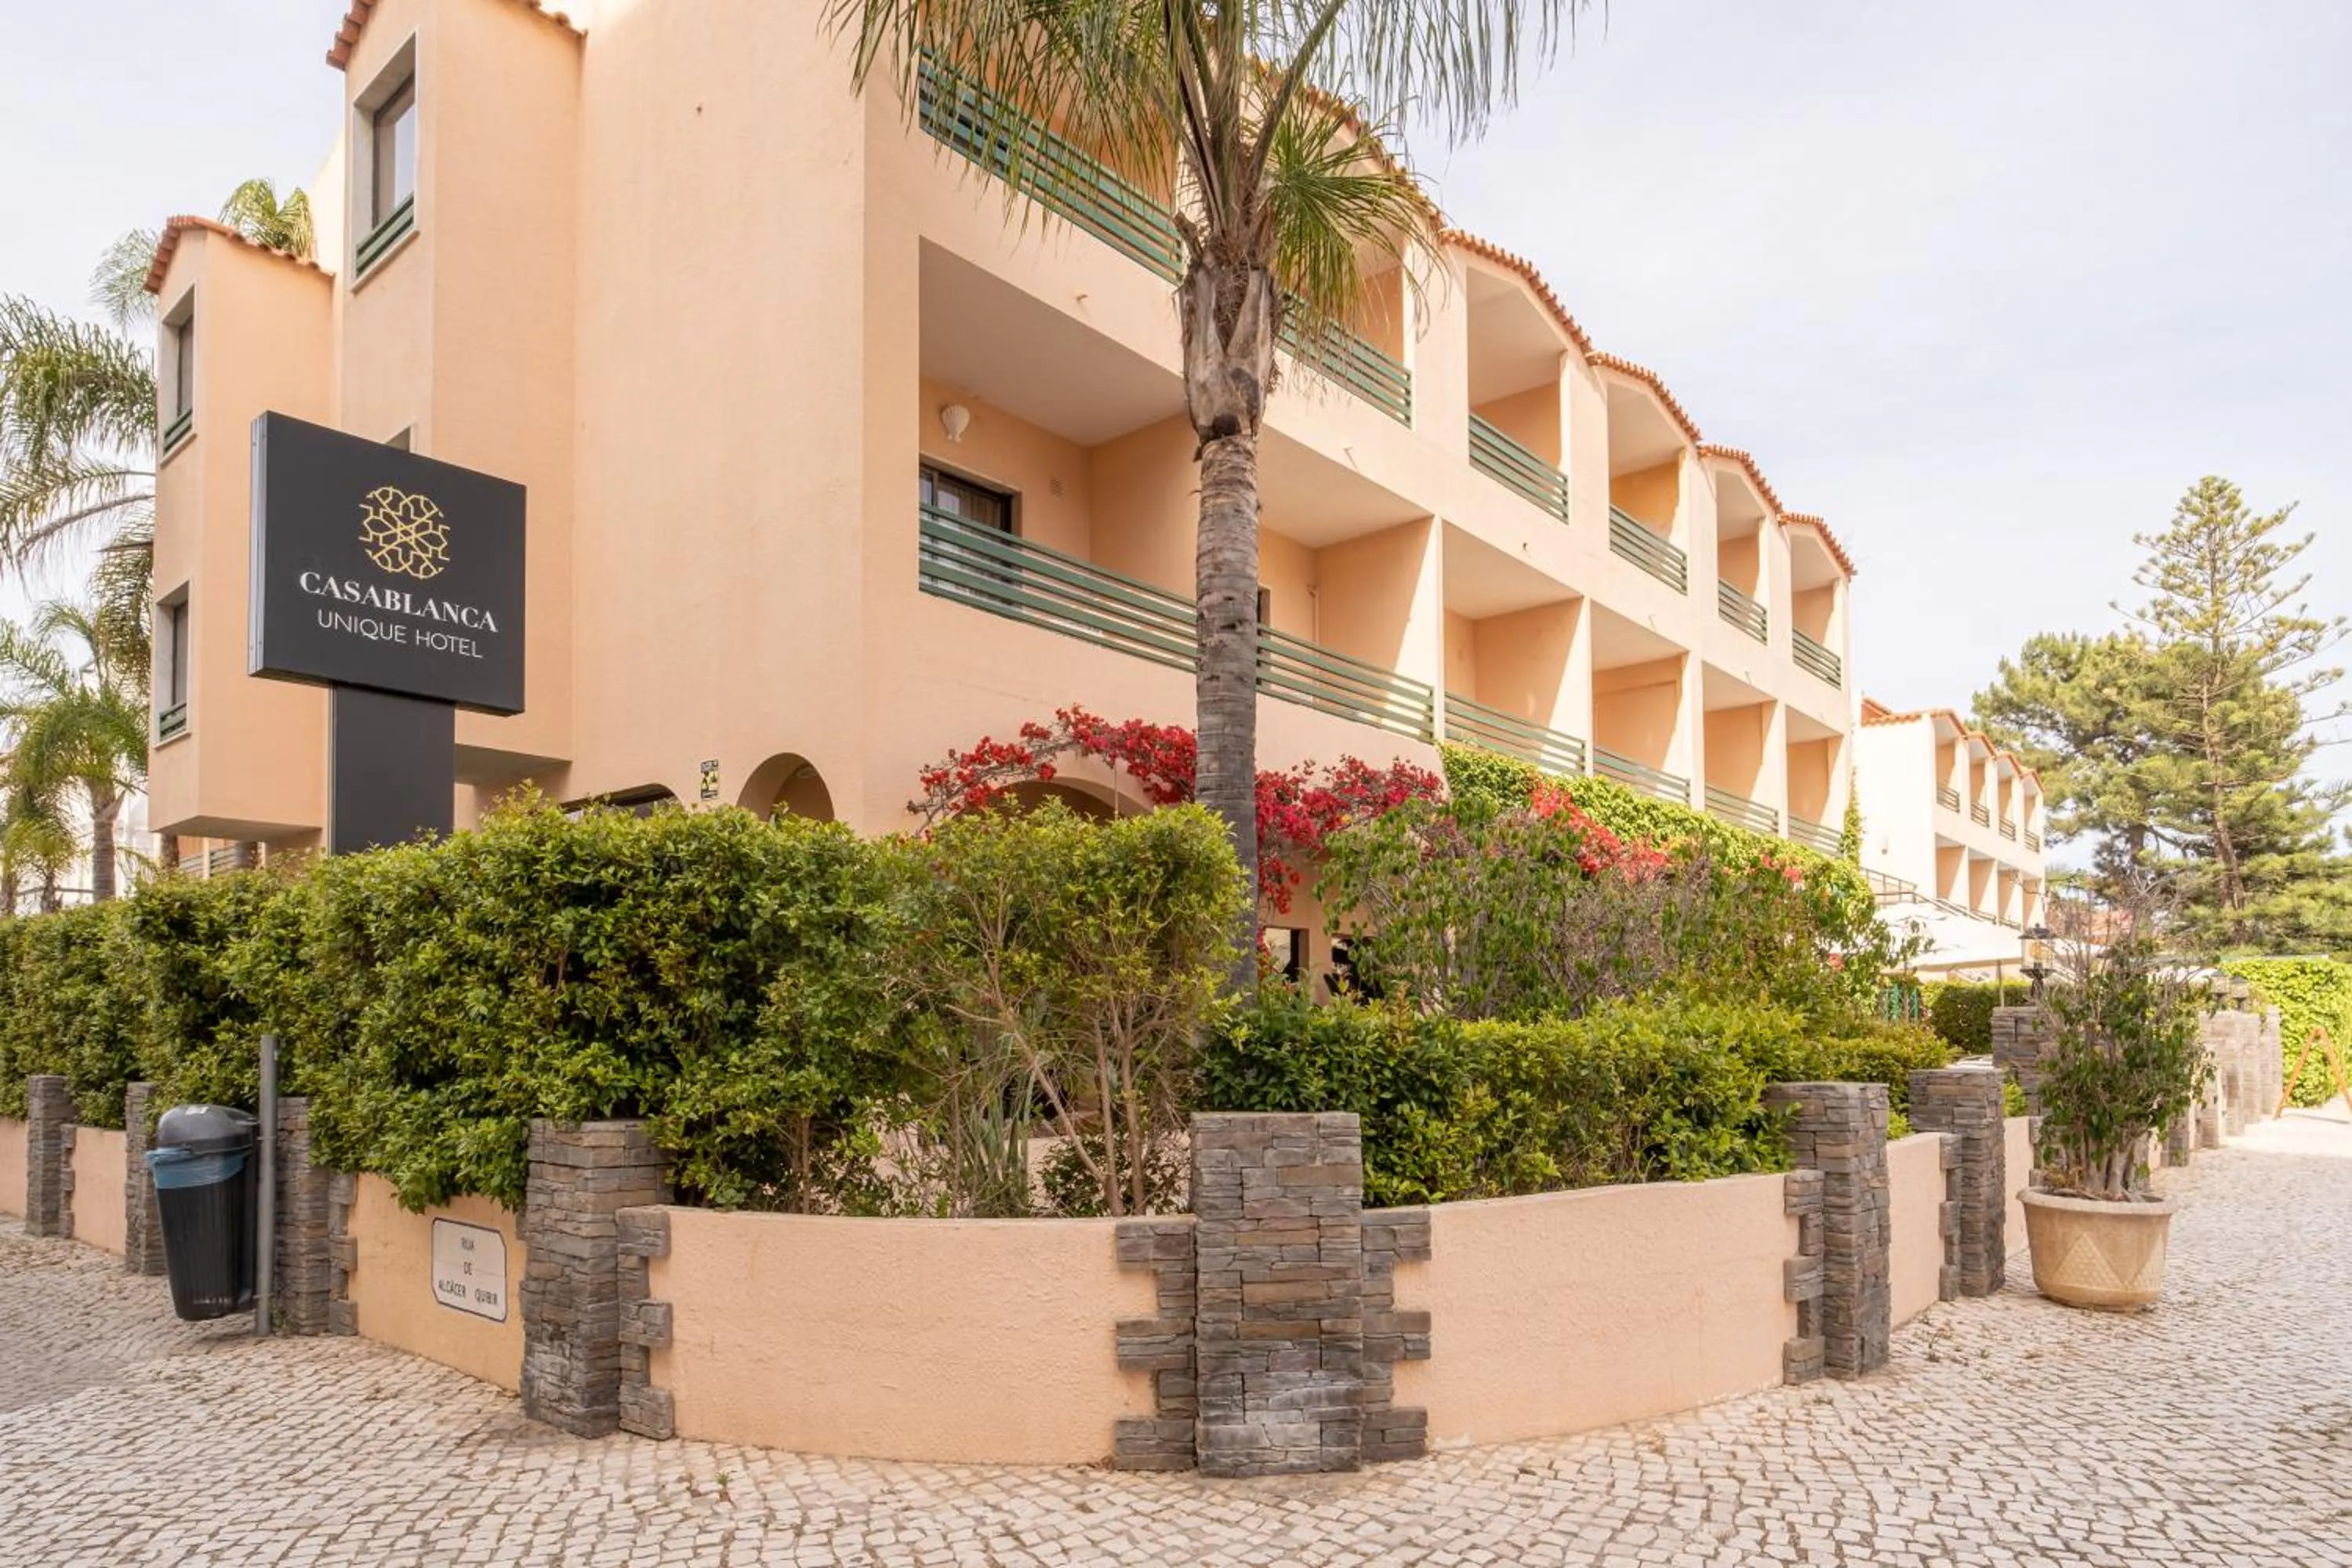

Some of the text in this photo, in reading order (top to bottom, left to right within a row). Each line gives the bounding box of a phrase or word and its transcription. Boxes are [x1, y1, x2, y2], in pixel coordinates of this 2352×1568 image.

[299, 571, 499, 633] CASABLANCA
[317, 608, 484, 659] UNIQUE HOTEL
[461, 1237, 474, 1250] RUA
[463, 1261, 472, 1275] DE
